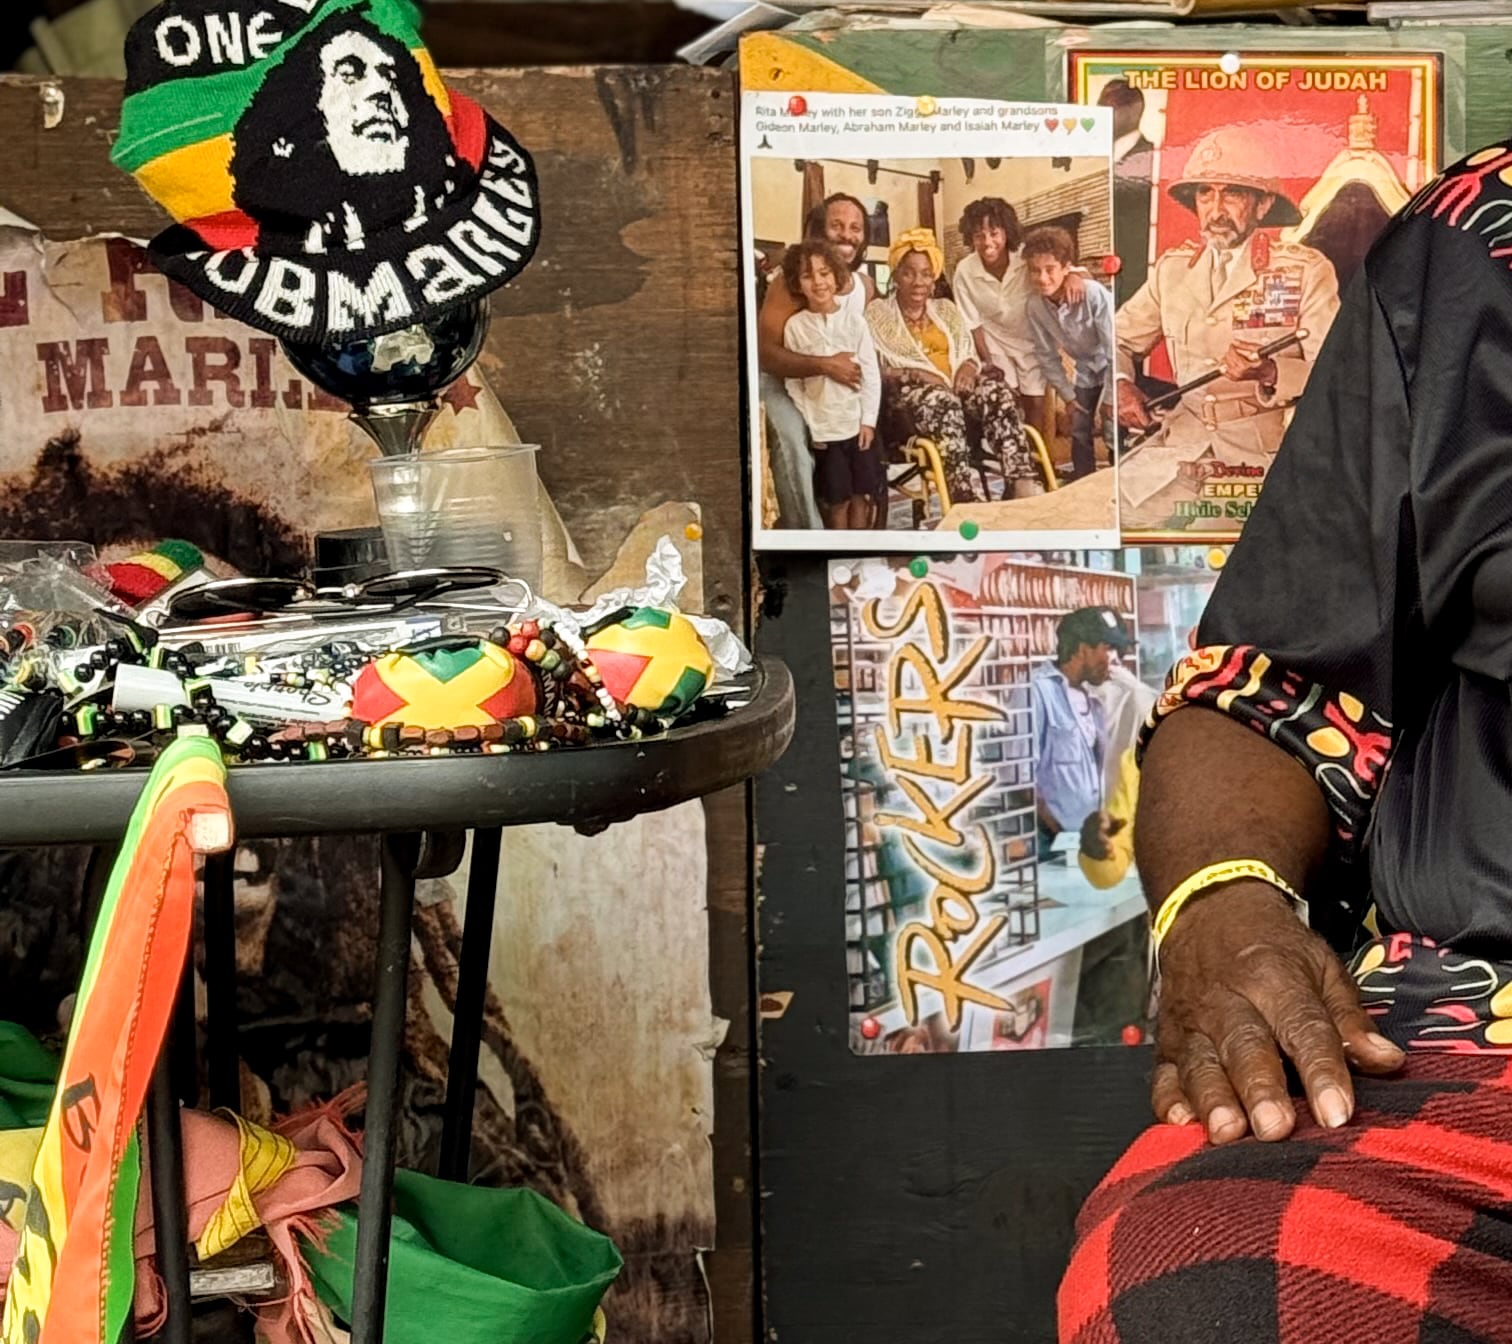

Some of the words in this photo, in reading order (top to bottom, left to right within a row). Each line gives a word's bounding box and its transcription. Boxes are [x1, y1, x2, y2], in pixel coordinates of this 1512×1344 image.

[154, 9, 285, 68] ONE
[1124, 70, 1178, 90] THE
[1186, 70, 1248, 90] LION
[1256, 70, 1291, 90] OF
[1298, 70, 1389, 91] JUDAH
[755, 106, 778, 118] Rita
[821, 106, 846, 118] with
[849, 106, 869, 118] her
[871, 108, 894, 118] son
[973, 106, 995, 118] and
[997, 106, 1058, 119] grandsons
[755, 121, 796, 133] Gideon
[798, 121, 840, 135] Marley,
[843, 120, 896, 133] Abraham
[898, 120, 937, 135] Marley
[940, 120, 962, 132] and
[964, 119, 999, 132] Isaiah
[1001, 119, 1040, 134] Marley
[1174, 500, 1223, 519] Haile
